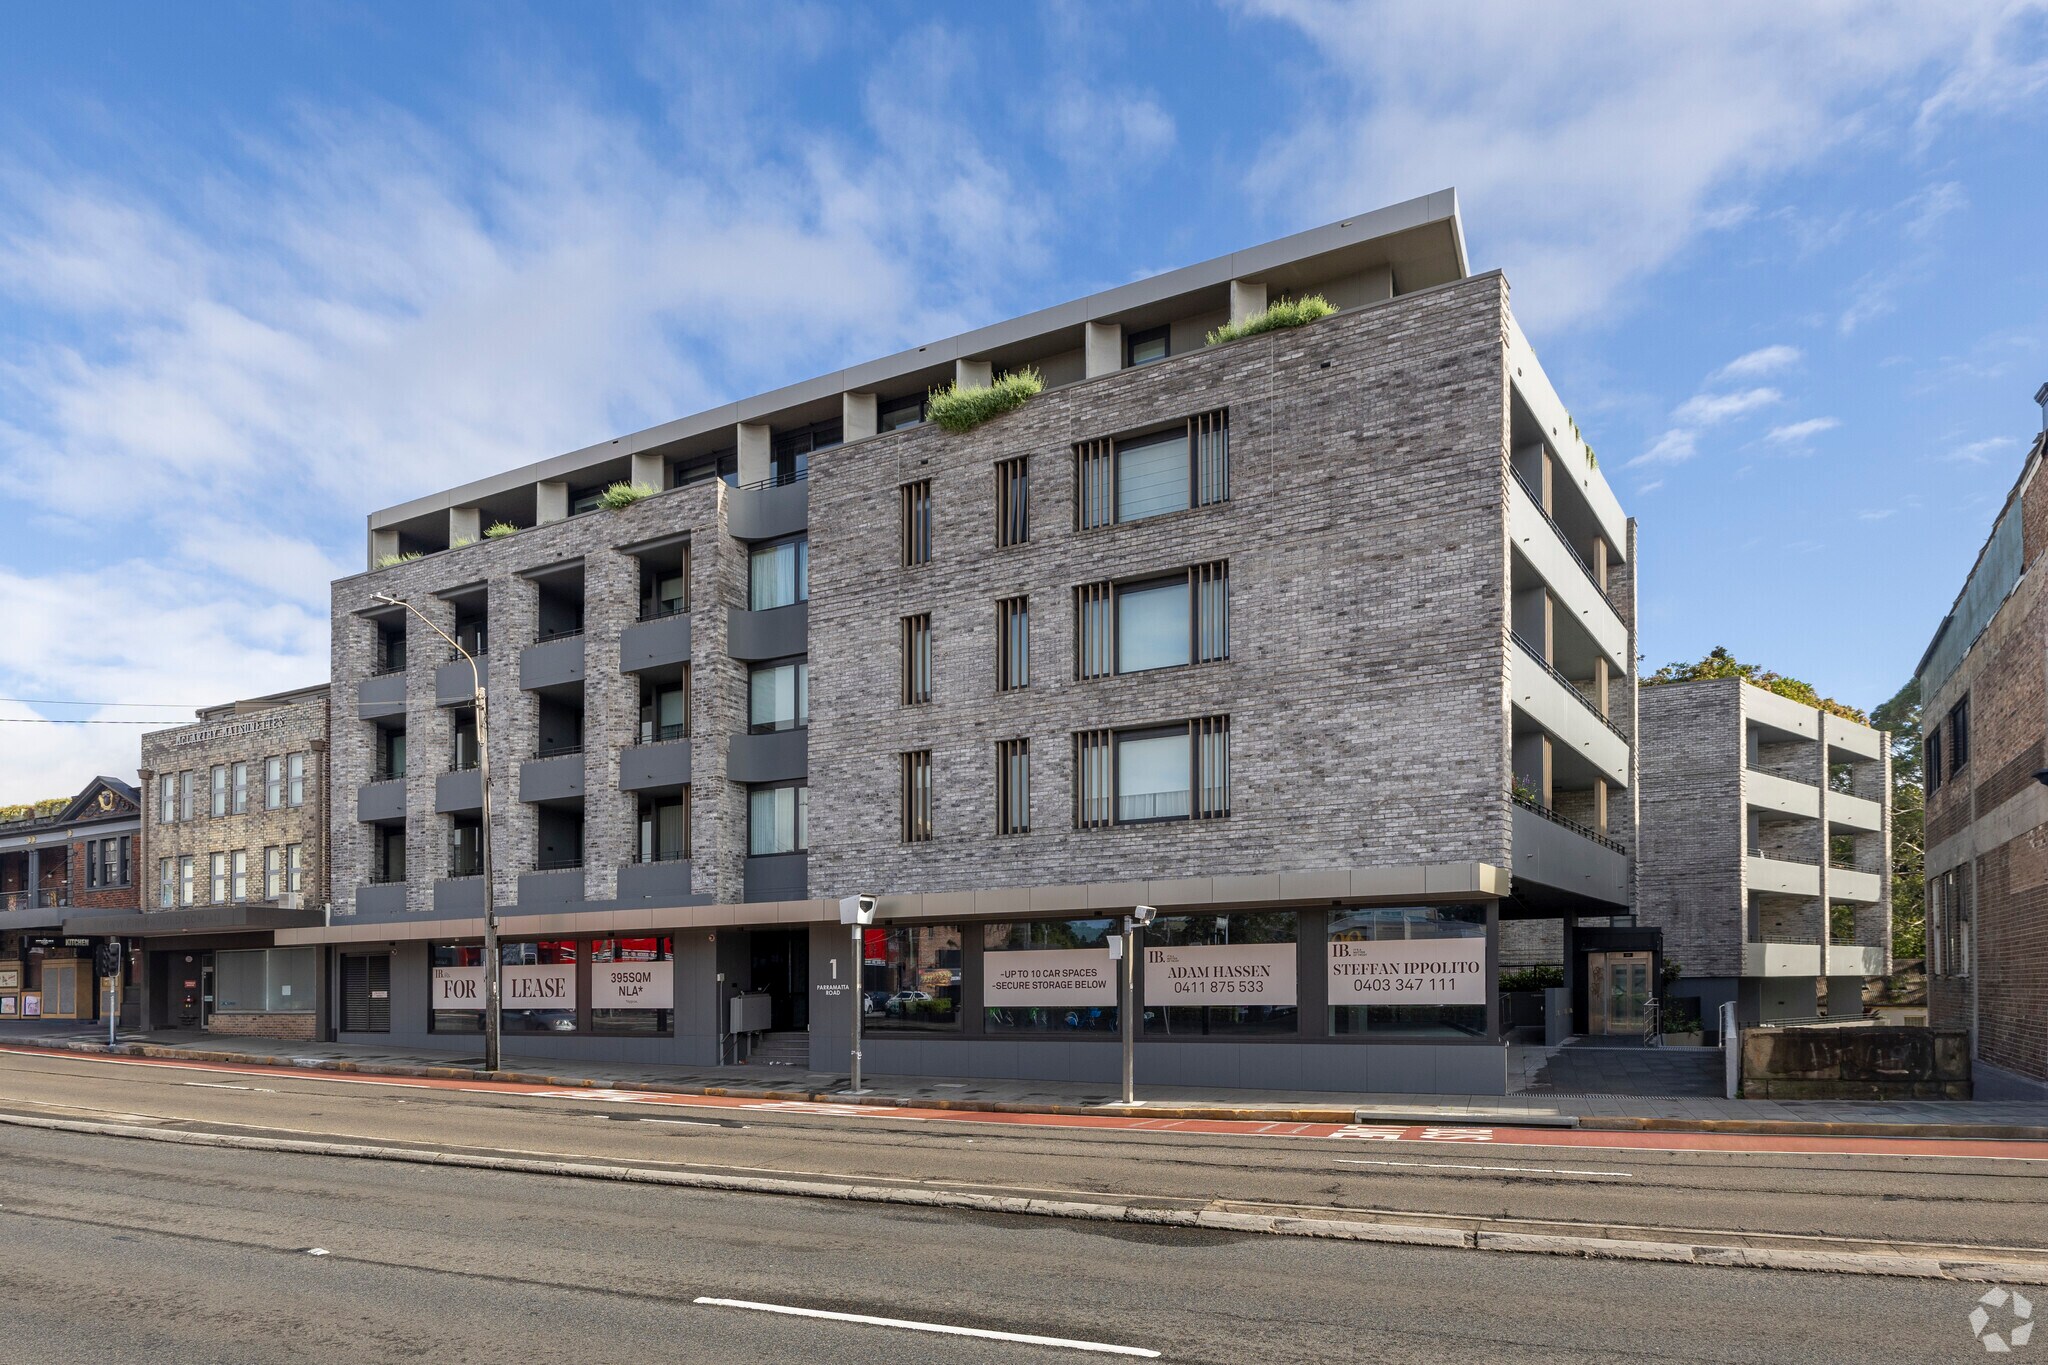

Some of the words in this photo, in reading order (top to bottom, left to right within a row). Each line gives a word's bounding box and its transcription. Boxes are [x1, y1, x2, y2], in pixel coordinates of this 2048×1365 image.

[1149, 951, 1165, 963] IB.
[1333, 944, 1351, 957] IB.
[829, 959, 837, 979] 1
[1043, 969, 1061, 977] CAR
[1062, 969, 1097, 977] SPACES
[1168, 966, 1210, 978] ADAM
[1213, 965, 1271, 977] HASSEN
[1333, 963, 1400, 975] STEFFAN
[1404, 961, 1480, 974] IPPOLITO
[611, 972, 651, 983] 395SQM
[443, 980, 476, 998] FOR
[511, 978, 565, 998] LEASE
[992, 981, 1030, 990] -SECURE
[1032, 980, 1073, 989] STORAGE
[1074, 980, 1106, 989] BELOW
[1174, 981, 1205, 993] 0411
[1210, 981, 1234, 992] 875
[1239, 981, 1263, 992] 533
[1354, 979, 1390, 991] 0403
[1395, 979, 1423, 991] 347
[1429, 978, 1455, 990] 111
